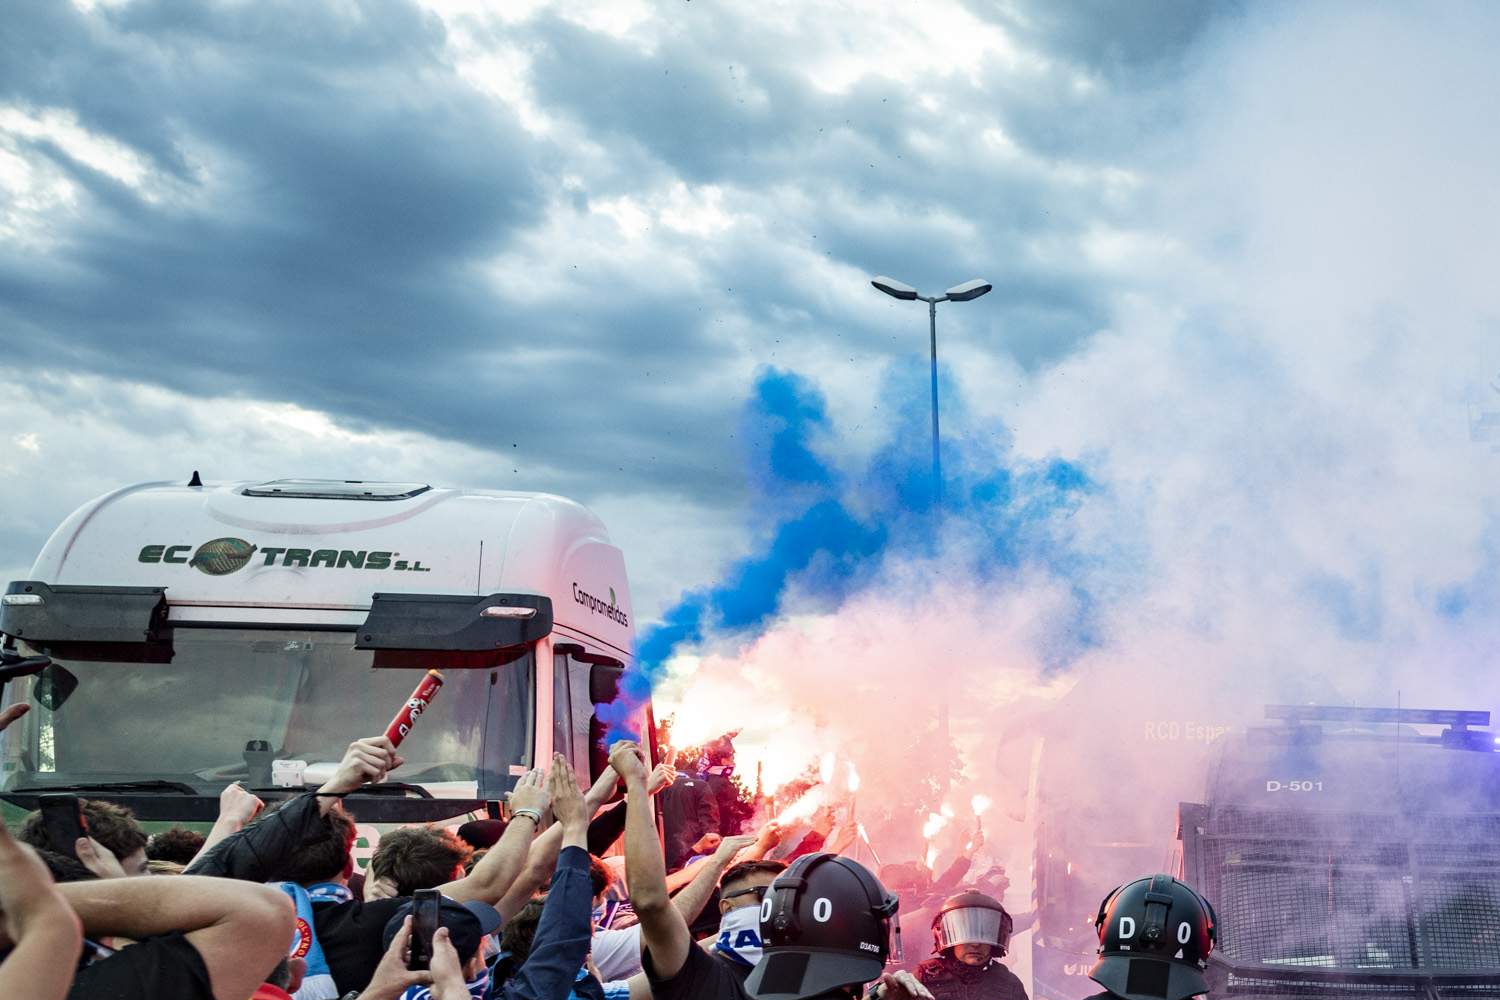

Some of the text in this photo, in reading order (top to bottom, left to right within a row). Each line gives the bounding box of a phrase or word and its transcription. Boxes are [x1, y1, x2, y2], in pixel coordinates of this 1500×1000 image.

[1144, 721, 1232, 745] RCD Espa
[1266, 780, 1324, 792] D-501
[1119, 916, 1136, 939] D
